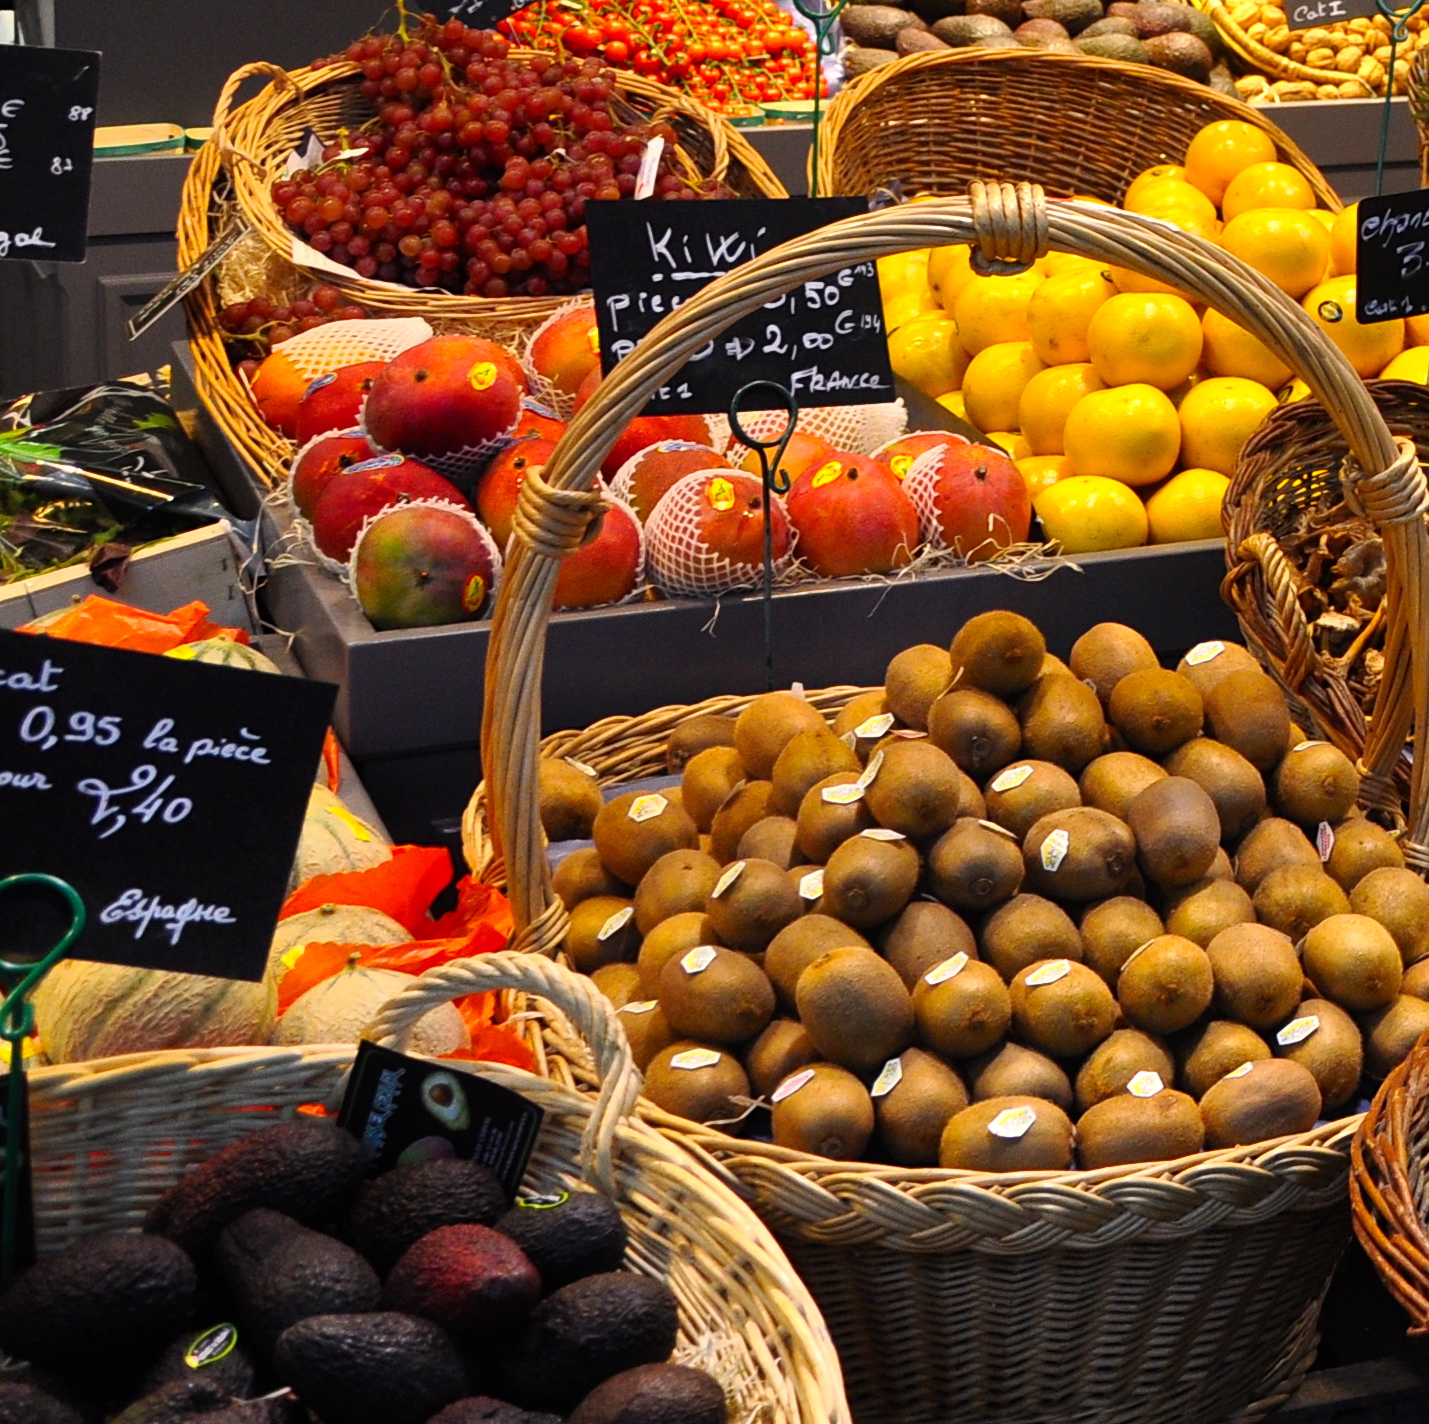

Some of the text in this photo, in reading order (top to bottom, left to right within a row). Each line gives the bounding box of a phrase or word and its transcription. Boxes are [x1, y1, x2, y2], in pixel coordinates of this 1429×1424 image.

[19, 706, 122, 751] 0,95
[143, 718, 179, 752] la
[100, 889, 237, 945] Espagne
